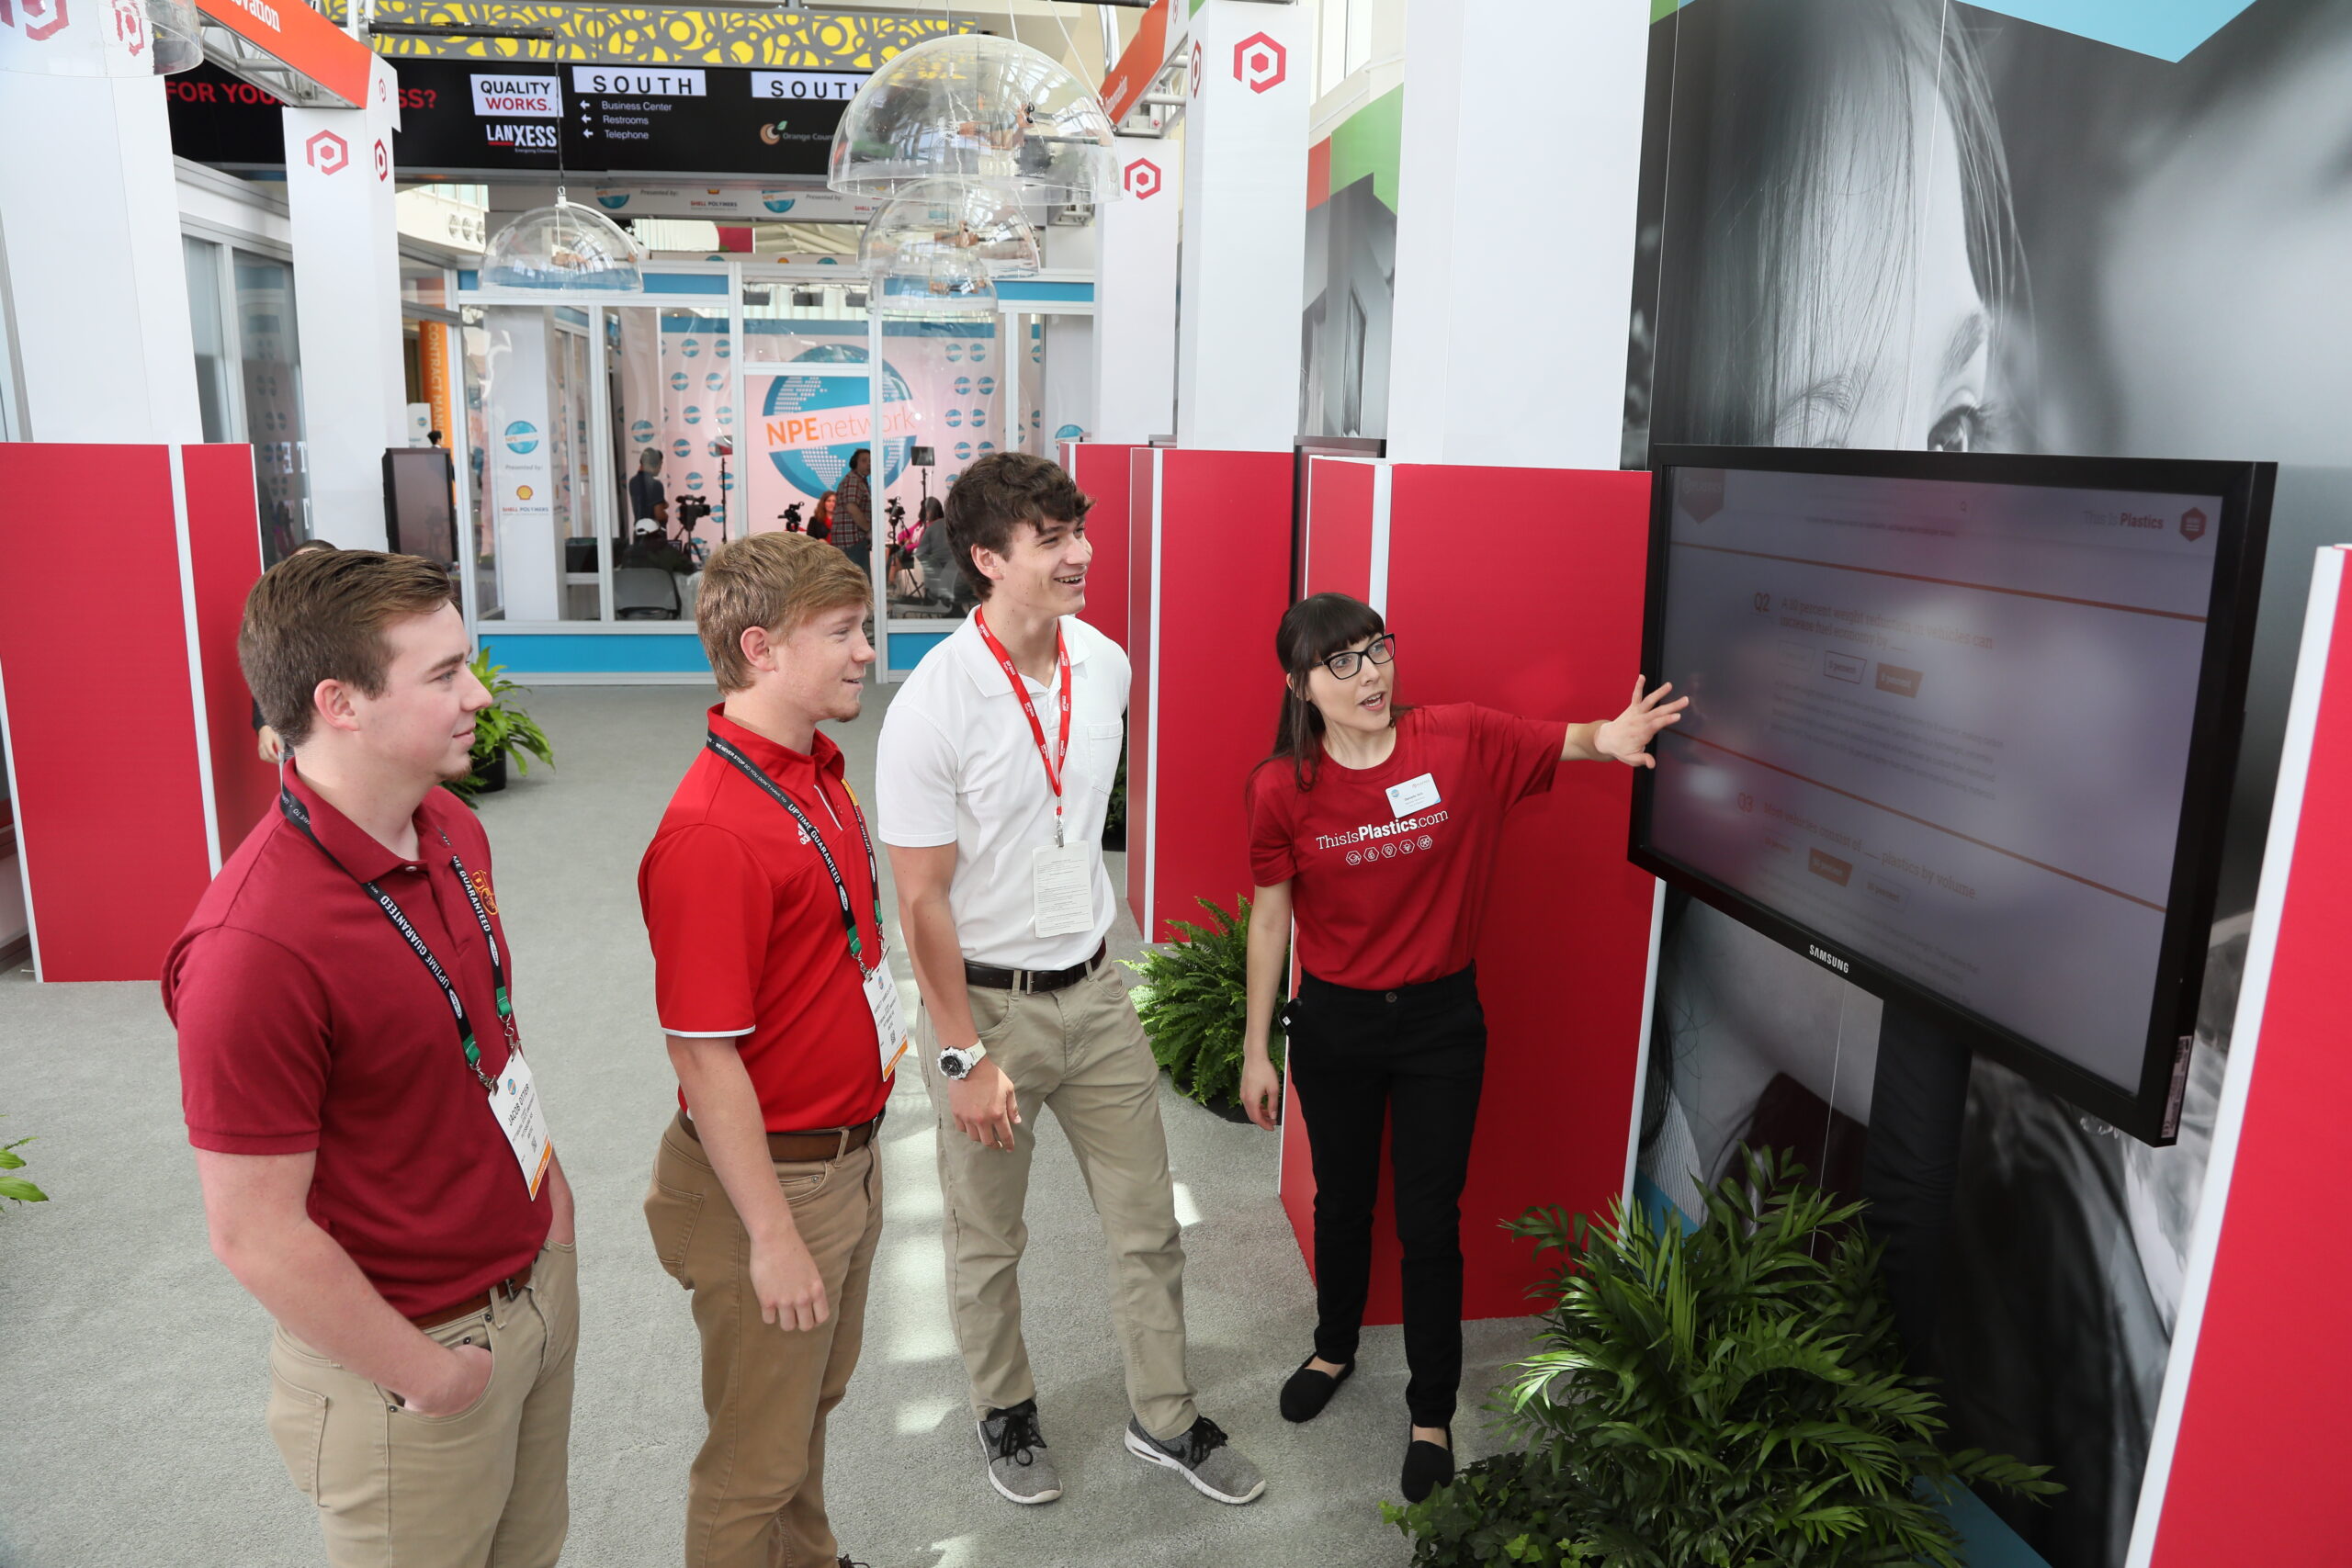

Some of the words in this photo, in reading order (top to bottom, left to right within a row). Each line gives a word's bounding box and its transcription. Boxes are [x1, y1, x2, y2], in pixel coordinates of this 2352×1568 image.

[165, 82, 215, 103] FOR
[220, 83, 284, 105] YOU
[481, 80, 550, 95] QUALITY
[593, 75, 692, 95] SOUTH
[485, 97, 551, 111] WORKS.
[602, 100, 640, 111] Business
[643, 102, 673, 111] Center
[603, 115, 650, 125] Restrooms
[486, 124, 557, 147] LANXESS
[605, 129, 650, 140] Telephone
[783, 133, 810, 141] Orange
[427, 322, 442, 391] CONTRACT
[2120, 512, 2164, 529] Plastics
[1753, 592, 1771, 613] Q2
[1973, 634, 1993, 649] can
[733, 755, 746, 765] STOP
[750, 769, 759, 778] YOU
[1316, 810, 1449, 850] ThisIsPlastics.com
[787, 804, 812, 830] UPTIME
[810, 830, 841, 884] GUARANTEED
[1881, 851, 1920, 876] plastics
[1921, 863, 1935, 885] by
[459, 870, 492, 932] GUARANTEED
[379, 895, 428, 956] GUARANTEED
[1808, 943, 1849, 974] SAMSUNG
[425, 953, 450, 989] UPTIME
[508, 1102, 521, 1126] JACOB
